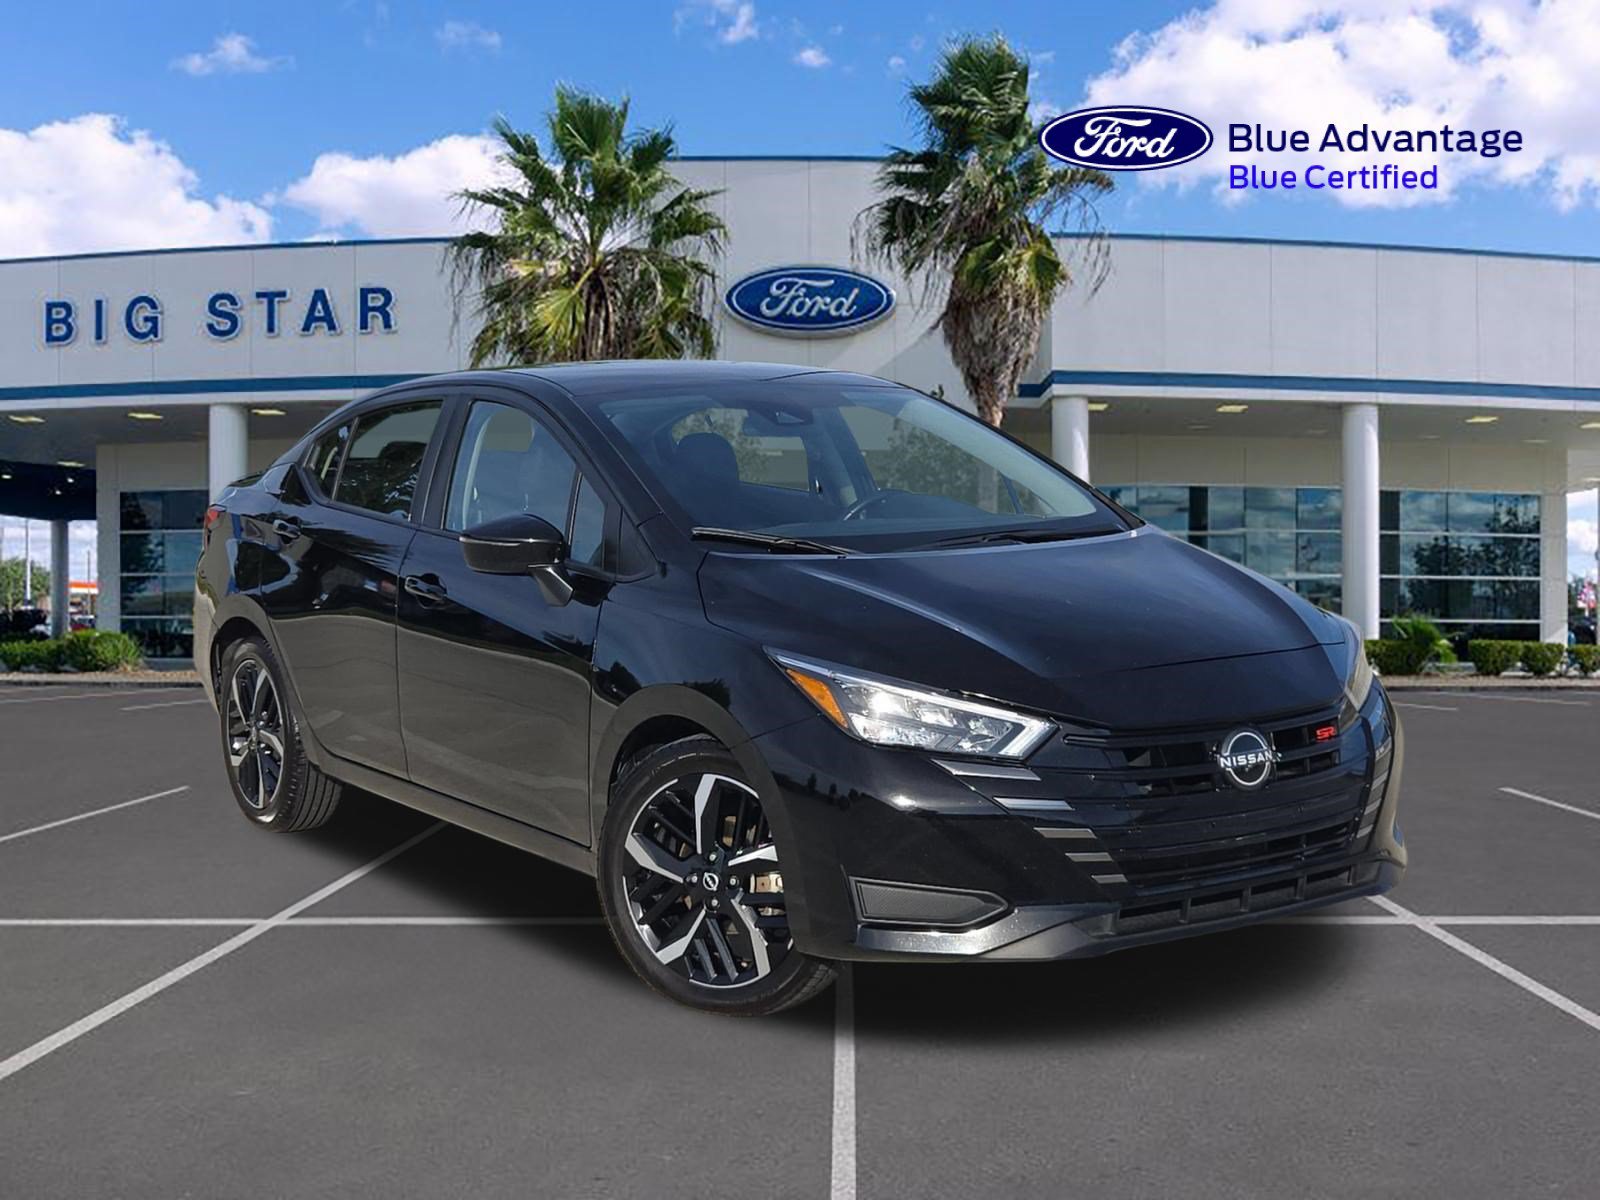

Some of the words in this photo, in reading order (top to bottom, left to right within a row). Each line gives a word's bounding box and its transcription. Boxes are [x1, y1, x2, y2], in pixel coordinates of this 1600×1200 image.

[759, 277, 858, 318] Ford
[45, 295, 162, 344] BIG
[206, 286, 397, 341] STAR
[1315, 726, 1336, 740] SR
[1219, 750, 1273, 768] NISSAN
